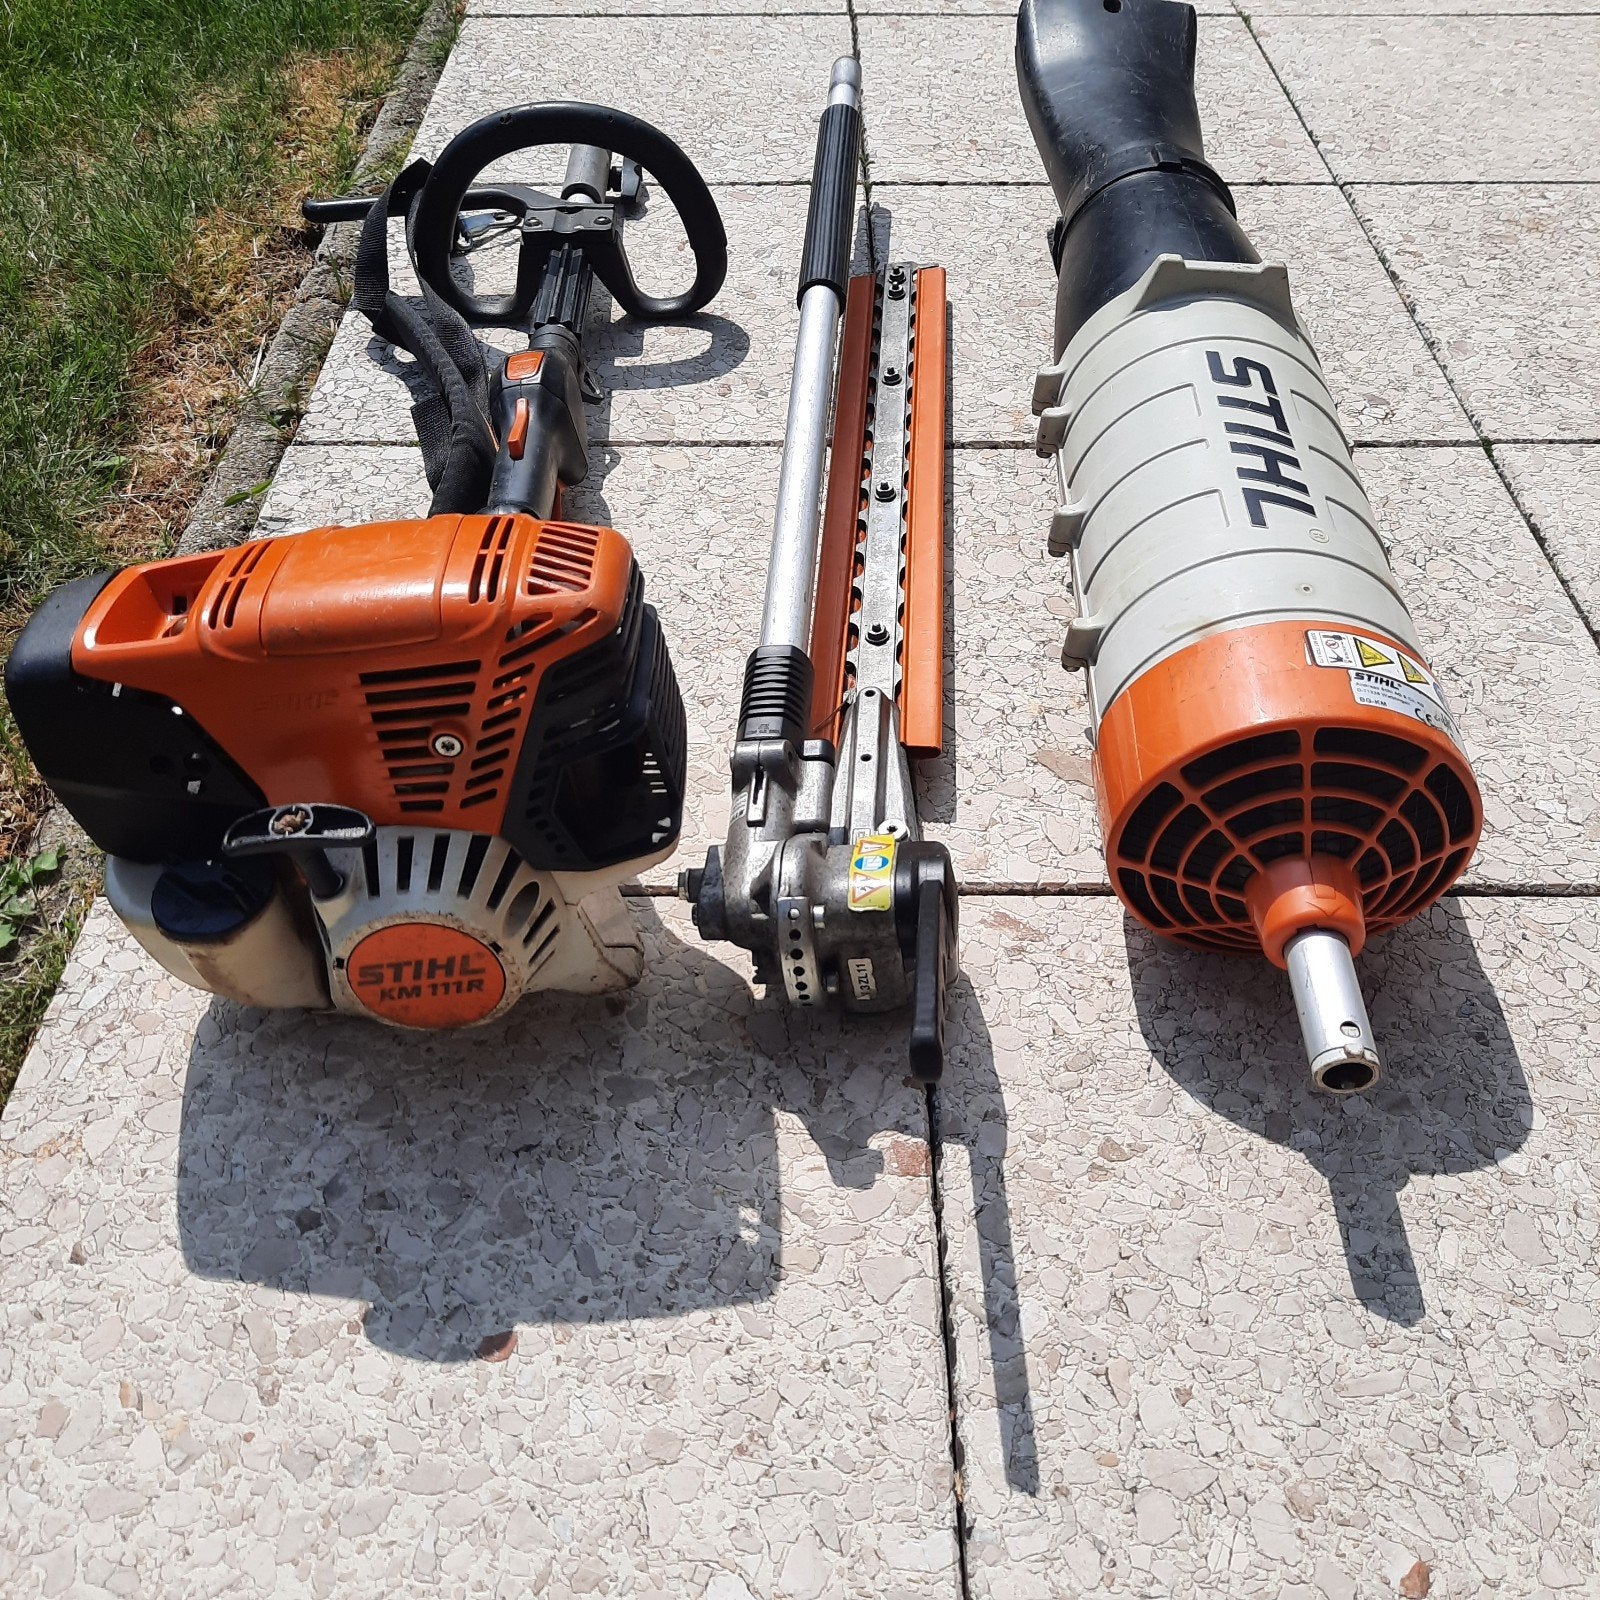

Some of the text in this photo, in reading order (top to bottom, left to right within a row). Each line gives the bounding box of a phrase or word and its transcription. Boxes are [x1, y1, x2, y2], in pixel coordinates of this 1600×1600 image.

[1205, 350, 1317, 528] STIHL
[1354, 672, 1400, 690] STIHL
[357, 953, 487, 988] STIHL
[379, 978, 485, 1003] KM 111R
